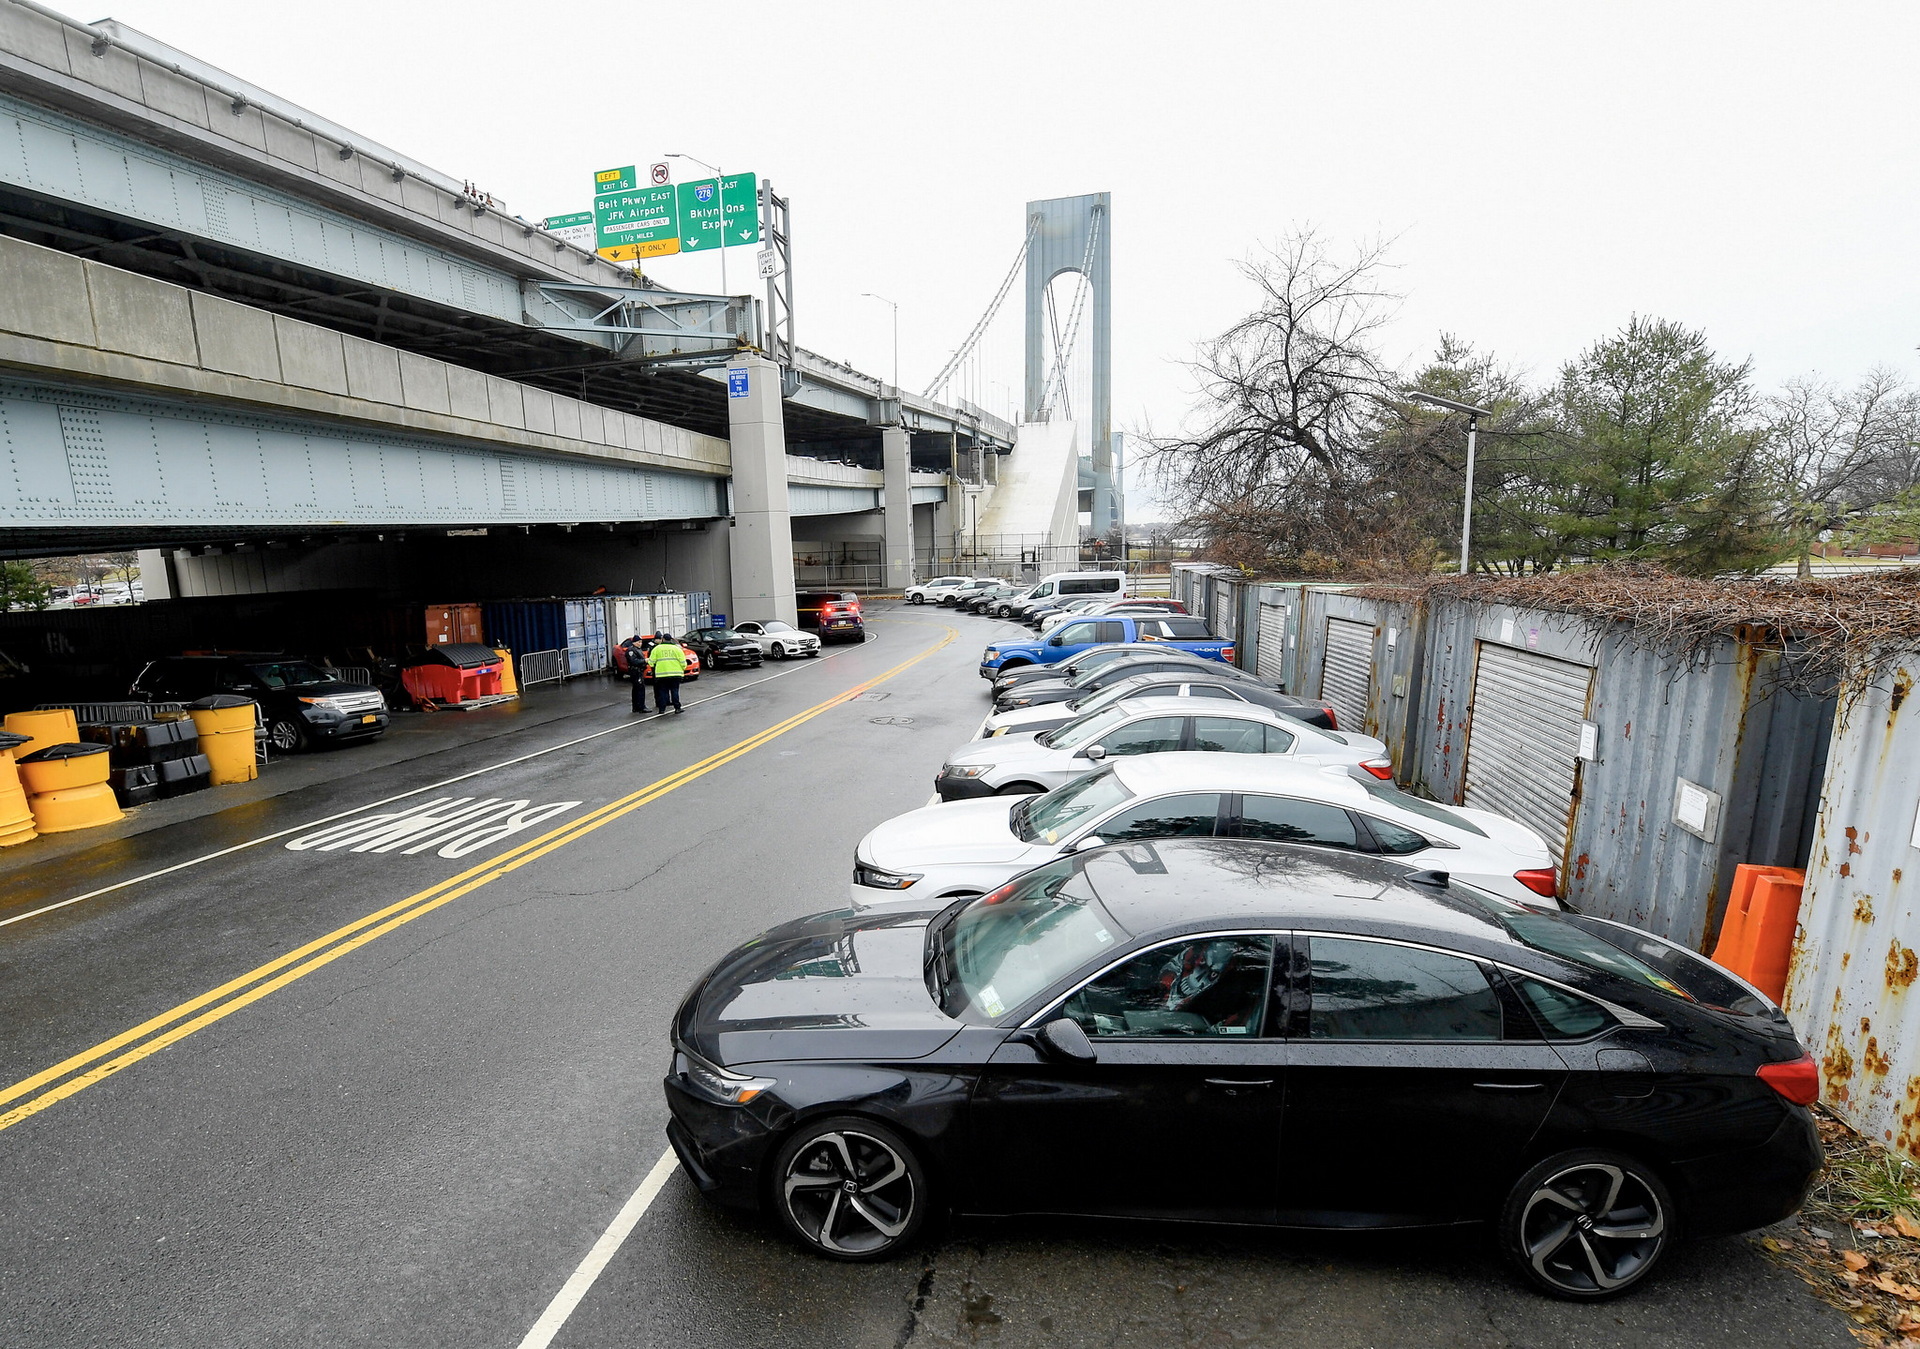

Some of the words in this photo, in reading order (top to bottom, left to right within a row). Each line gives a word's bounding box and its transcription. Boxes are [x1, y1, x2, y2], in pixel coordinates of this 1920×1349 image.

[600, 172, 616, 180] LEFT
[620, 180, 628, 188] 16
[698, 190, 710, 198] 278
[598, 199, 617, 209] Belt
[622, 196, 646, 206] Pkwy
[651, 192, 671, 201] EAST
[607, 211, 624, 221] JFK
[630, 206, 664, 217] Airport
[606, 223, 634, 232] PASSENGER
[702, 219, 734, 230] Expwy
[648, 243, 667, 251] ONLY
[762, 265, 773, 274] 45
